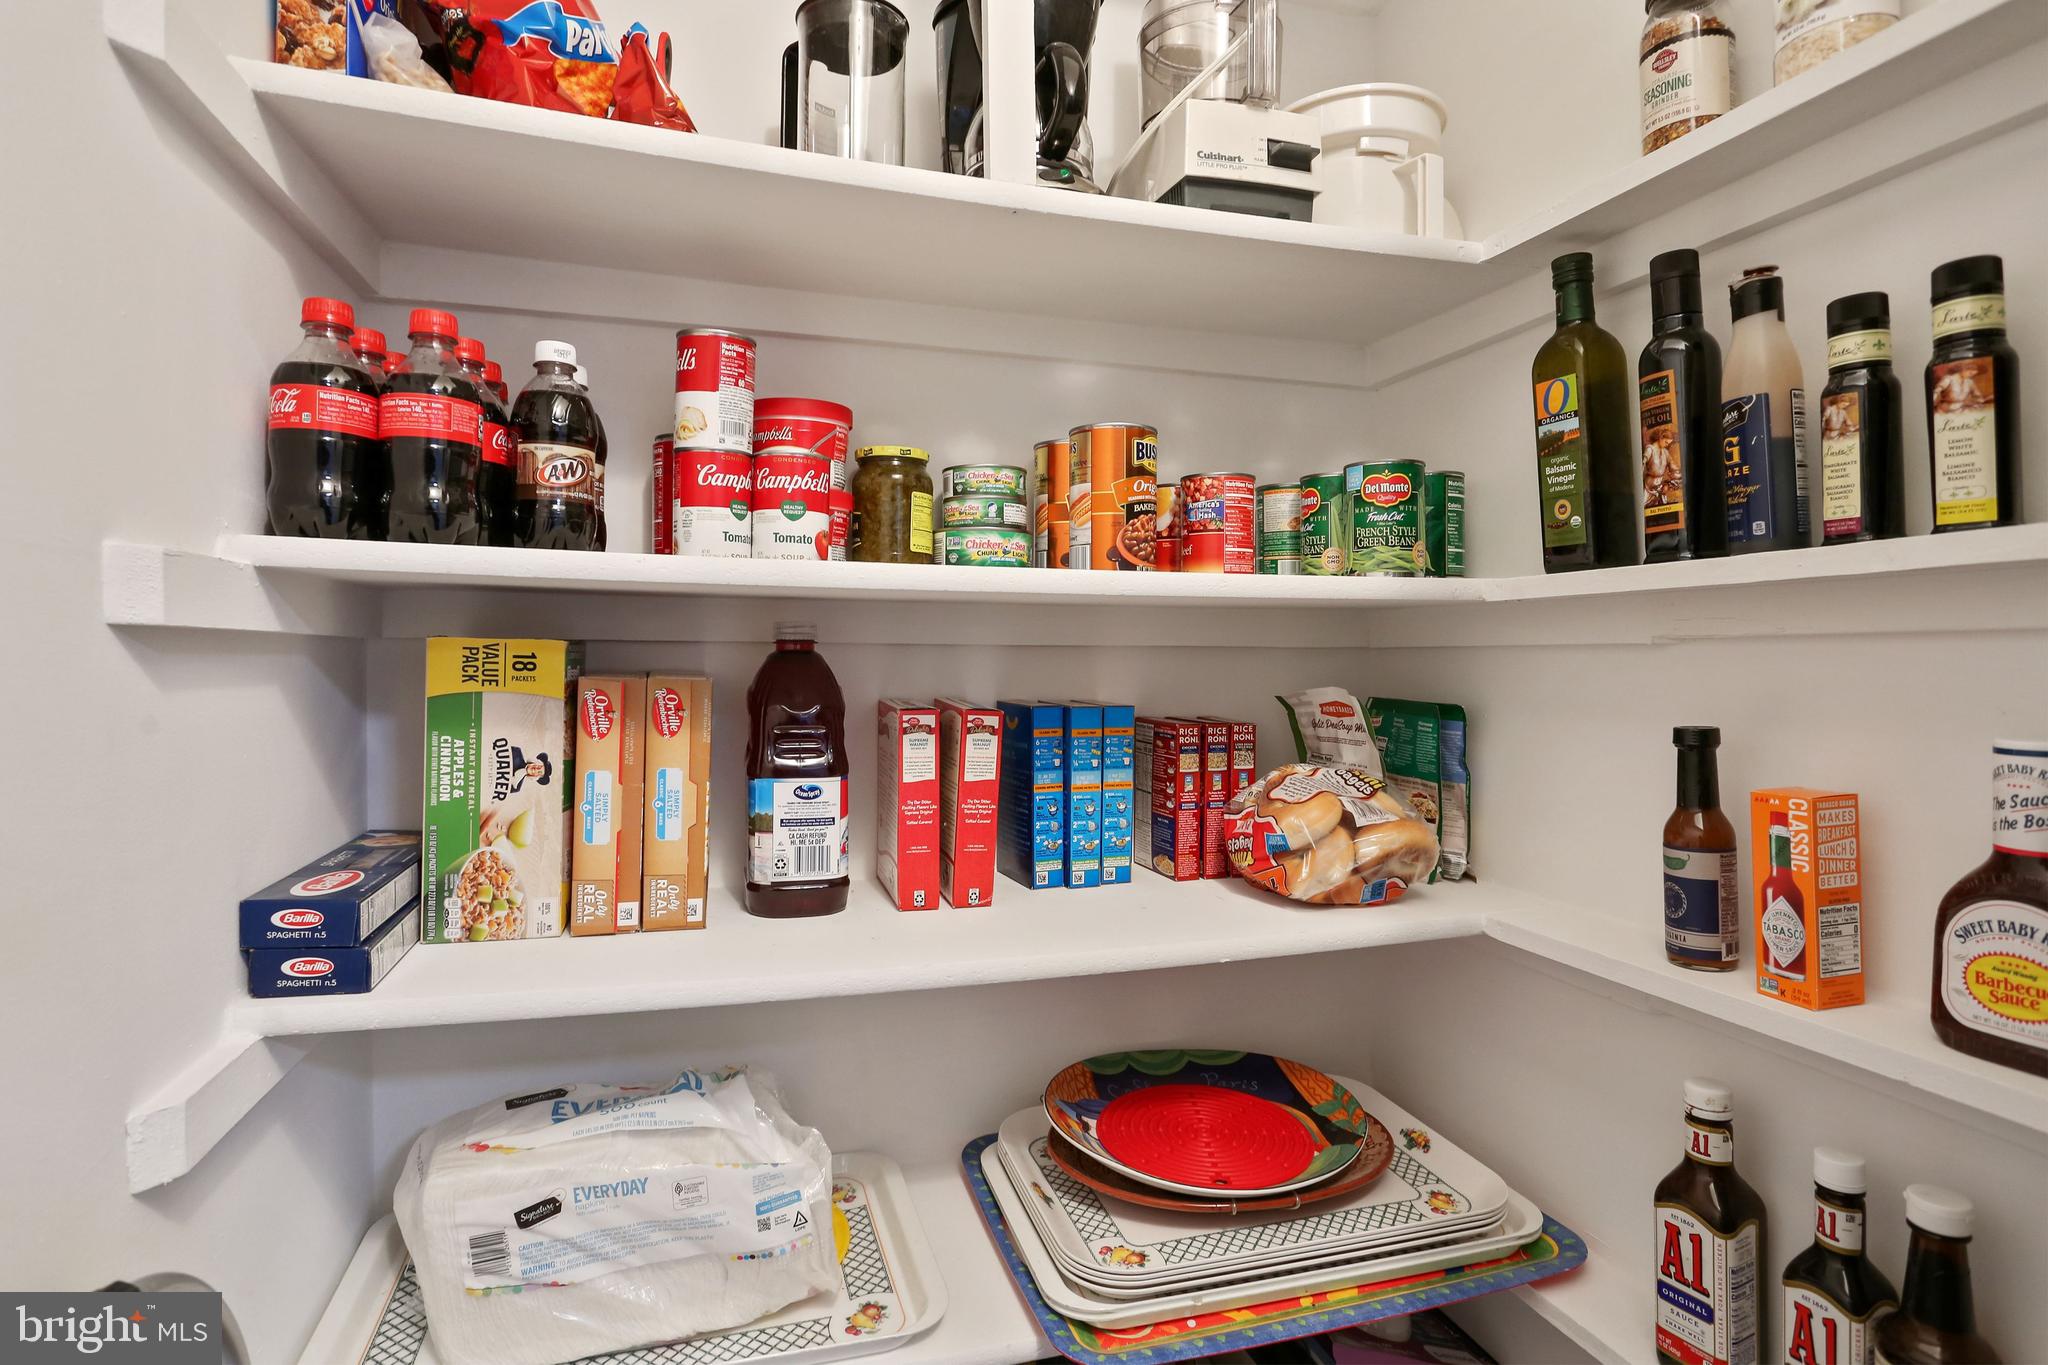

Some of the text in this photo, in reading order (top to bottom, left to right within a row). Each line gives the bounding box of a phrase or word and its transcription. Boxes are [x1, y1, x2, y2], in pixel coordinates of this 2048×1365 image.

[1643, 73, 1692, 107] SEASONING
[1652, 91, 1679, 110] GRINDER
[1197, 150, 1242, 163] Cuisinart
[721, 342, 745, 353] Nutrition
[721, 349, 737, 357] Facts
[320, 391, 360, 405] Nutrition Facts
[1543, 378, 1570, 417] O
[1541, 411, 1575, 425] ORGANICS
[1657, 413, 1671, 423] OIL
[753, 427, 793, 443] ampbell's
[773, 457, 816, 465] CONDENSED
[1550, 455, 1570, 464] organic
[547, 463, 581, 481] A&W
[967, 471, 996, 480] Chicken
[1545, 462, 1577, 475] Balsamic
[1547, 473, 1576, 485] Vinegar
[1365, 480, 1409, 494] Del Monte
[1133, 503, 1153, 512] BAKED
[1188, 501, 1220, 509] America's
[1354, 506, 1374, 514] MADE
[1366, 511, 1388, 523] Fresh
[773, 532, 813, 545] Tomato
[1356, 525, 1416, 538] FRENCH STYLE
[965, 539, 1003, 550] Chicken
[1305, 535, 1326, 545] STYLE
[1357, 535, 1416, 547] GREEN BEANS
[976, 549, 999, 557] CHUNK
[460, 646, 480, 684] PACK
[481, 643, 500, 687] VALUE
[511, 652, 537, 673] 18
[583, 689, 601, 743] Redenbacher's
[594, 696, 611, 734] Orville
[654, 688, 671, 740] Redenbacher's
[666, 694, 681, 732] Orville
[1207, 727, 1227, 735] RICE
[1233, 725, 1254, 733] RICE
[1179, 736, 1198, 744] RONI
[1207, 735, 1227, 743] RONI
[1233, 733, 1253, 741] RONI
[439, 735, 451, 801] CINNAMON
[452, 739, 465, 798] APPLES &
[467, 729, 476, 811] INSTANT OATMEAL
[491, 738, 511, 802] QUAKER
[2007, 763, 2034, 775] BABY
[795, 788, 821, 798] Ocean Spray
[594, 792, 602, 823] SALTED
[601, 793, 609, 823] SIMPLY
[666, 788, 674, 819] SALTED
[1818, 811, 1854, 824] MAKES
[1999, 816, 2018, 831] the
[796, 831, 828, 840] CASH REFUND
[1788, 798, 1810, 873] CLASSIC
[1818, 825, 1856, 843] BREAKFAST
[1228, 836, 1254, 853] bagels
[1819, 842, 1846, 857] LUNCH
[1819, 860, 1857, 874] DINNER
[1819, 874, 1856, 887] BETTER
[575, 883, 583, 924] INGREDIENTS
[583, 884, 595, 923] REAL
[594, 890, 607, 917] Only
[656, 879, 668, 917] REAL
[667, 885, 680, 911] Only
[283, 912, 321, 924] Barilla
[266, 931, 327, 940] SPAGHETTI n.5
[1763, 921, 1804, 940] TABASCO
[1820, 930, 1842, 938] Calories
[1954, 919, 2040, 944] SWEET BABY
[293, 961, 331, 972] Barilla
[276, 979, 337, 988] SPAGHETTI n.5
[1975, 970, 2048, 998] Barbecu
[1989, 989, 2040, 1011] Sauce
[1200, 1073, 1258, 1091] Paris
[573, 1177, 648, 1204] EVERYDAY
[519, 1201, 556, 1223] Signature
[1680, 1217, 1695, 1229] 1862
[1662, 1286, 1708, 1317] ORIGINAL
[1669, 1307, 1700, 1328] SAUCE
[1665, 1318, 1706, 1345] SHAKE WELL
